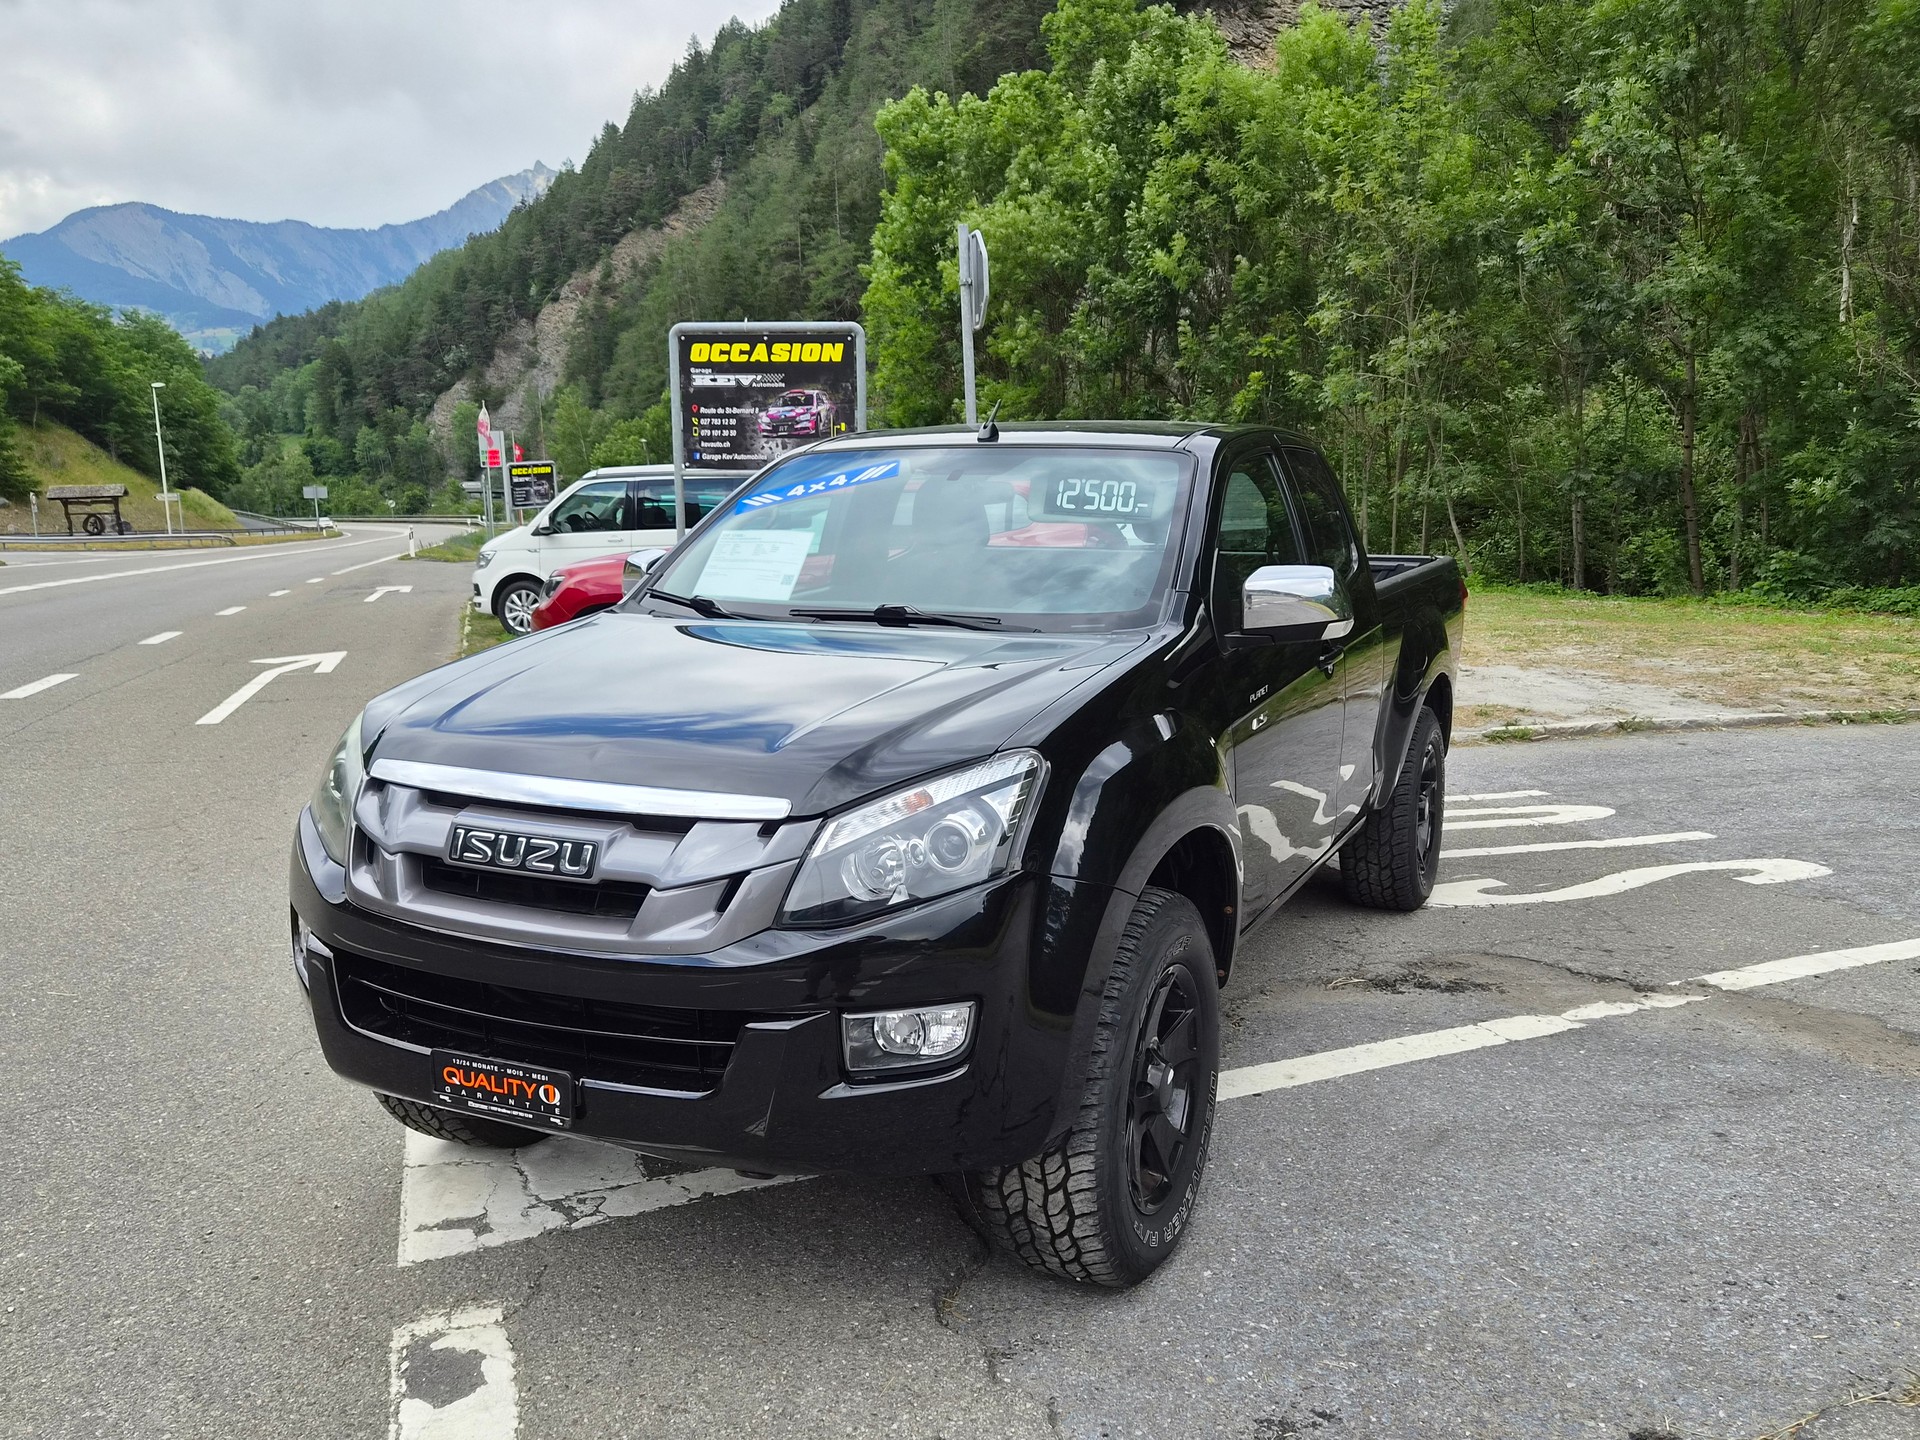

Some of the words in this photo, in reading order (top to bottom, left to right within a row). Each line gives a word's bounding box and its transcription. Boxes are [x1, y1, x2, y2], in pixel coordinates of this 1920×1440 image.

[690, 343, 844, 362] OCCASION
[690, 367, 712, 375] Garage
[702, 453, 721, 461] Garage
[511, 466, 551, 475] OCCASION
[451, 828, 593, 875] ISUZU
[452, 1058, 470, 1067] 12/24
[472, 1061, 498, 1072] MONATE
[506, 1068, 524, 1077] MOIS
[443, 1066, 537, 1099] QUALITY
